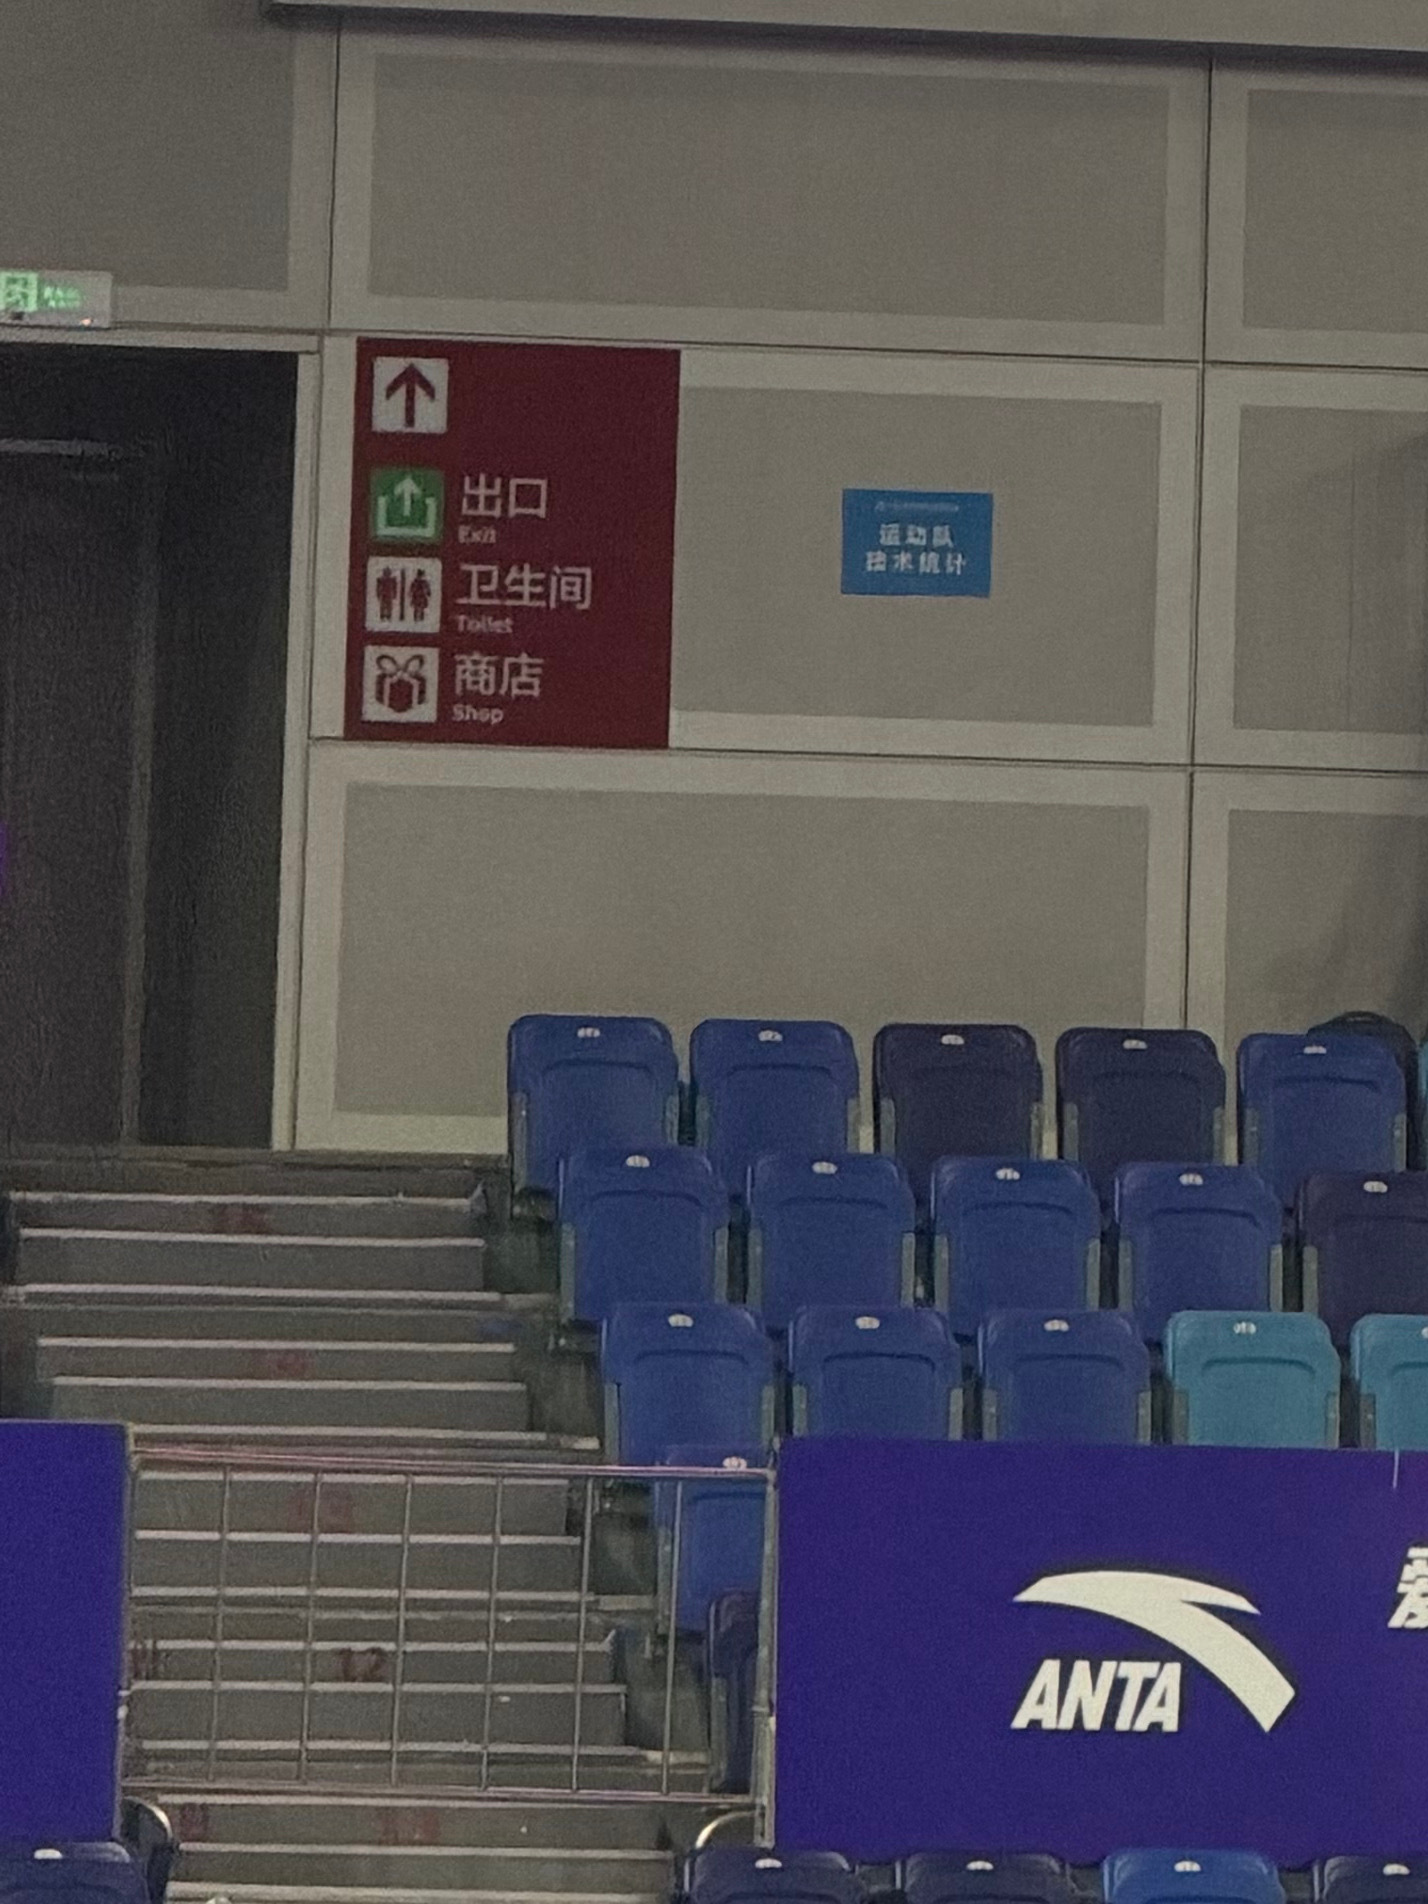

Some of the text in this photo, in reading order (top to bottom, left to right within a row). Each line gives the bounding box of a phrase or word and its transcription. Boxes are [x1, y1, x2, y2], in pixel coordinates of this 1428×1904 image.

[461, 472, 548, 519] 出口
[455, 562, 592, 610] 卫生间
[454, 651, 545, 699] 商店
[452, 703, 504, 725] Shop
[1010, 1659, 1183, 1733] ANTA
